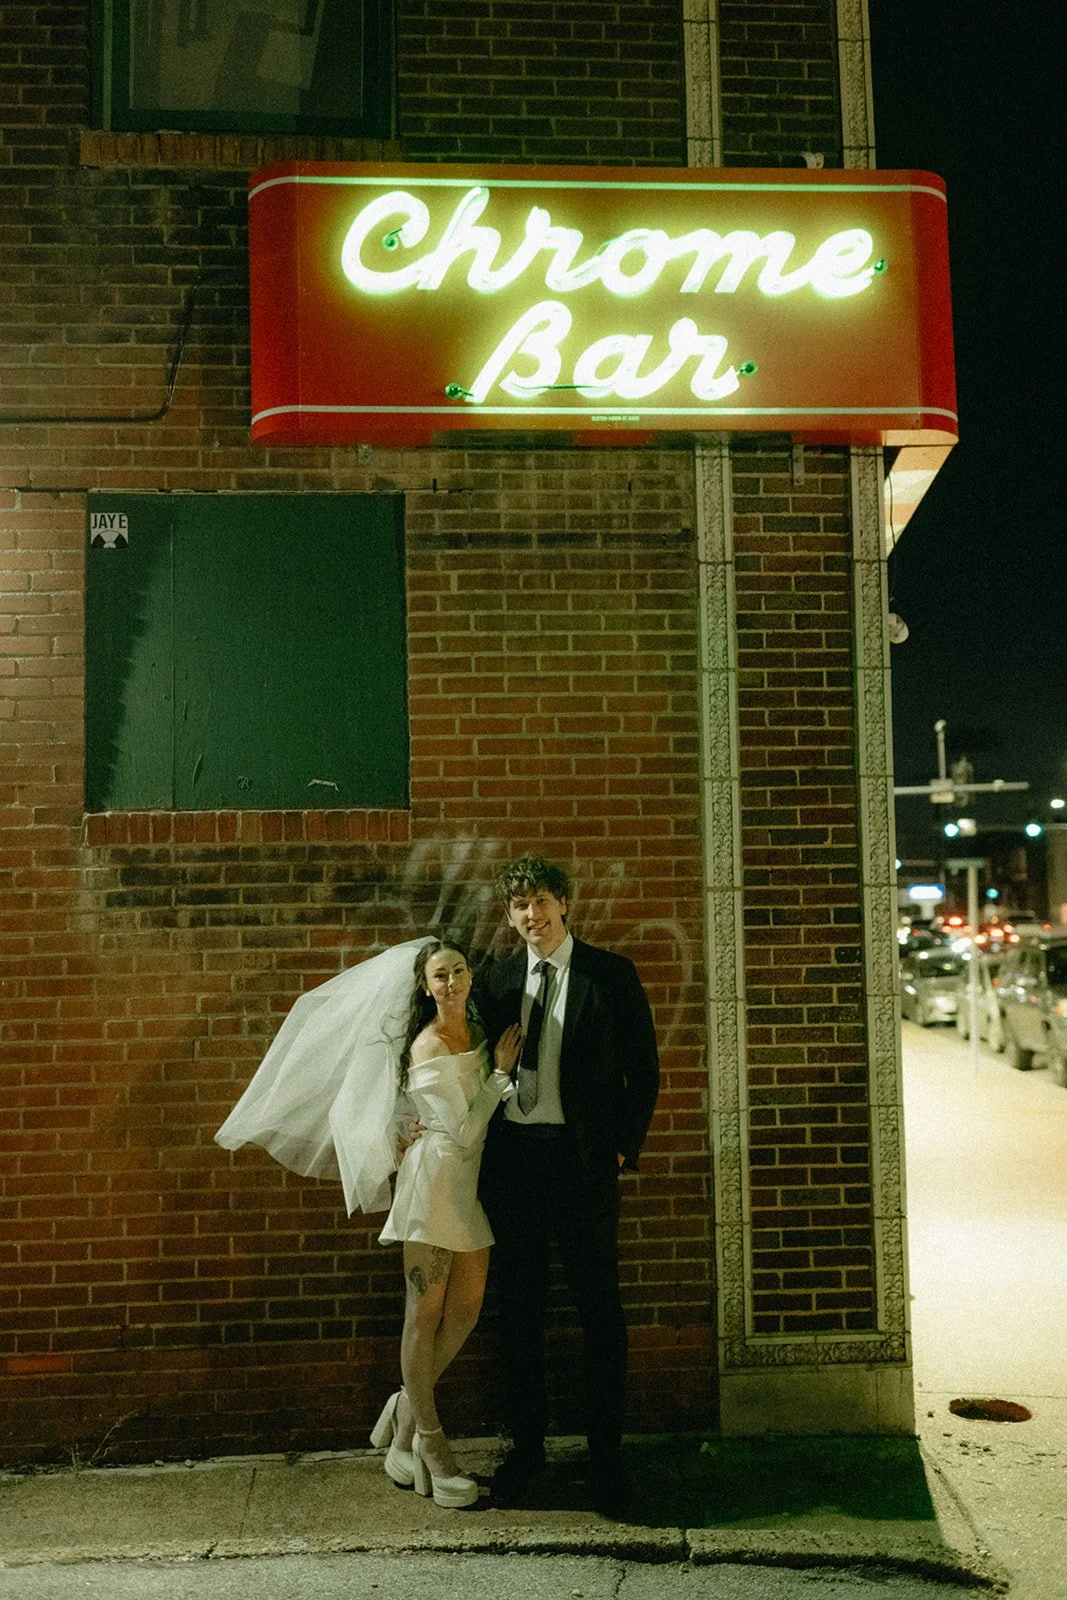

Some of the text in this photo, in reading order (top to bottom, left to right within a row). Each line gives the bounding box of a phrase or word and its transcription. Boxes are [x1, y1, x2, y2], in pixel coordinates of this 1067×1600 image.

[341, 187, 876, 298] Chrome
[465, 300, 741, 403] Bar
[92, 514, 127, 529] JAYE
